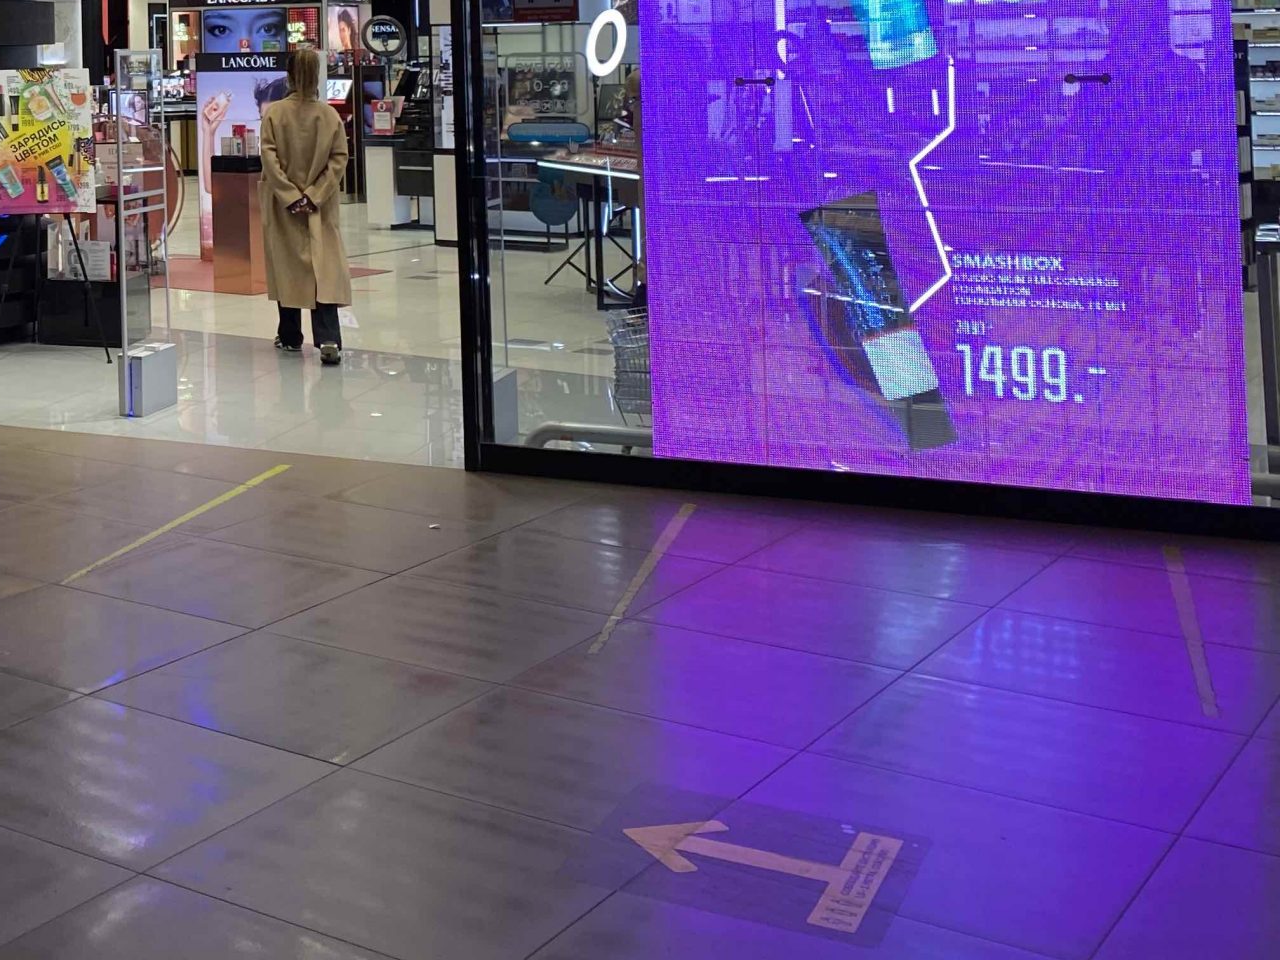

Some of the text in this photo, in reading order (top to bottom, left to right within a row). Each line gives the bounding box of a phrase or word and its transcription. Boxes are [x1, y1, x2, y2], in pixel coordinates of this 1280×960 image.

[221, 54, 277, 69] LANCÔME
[10, 120, 66, 153] ЗАРЯДИСЬ
[14, 134, 59, 162] ЦВЕТОМ
[952, 254, 1064, 271] SMASHBOX
